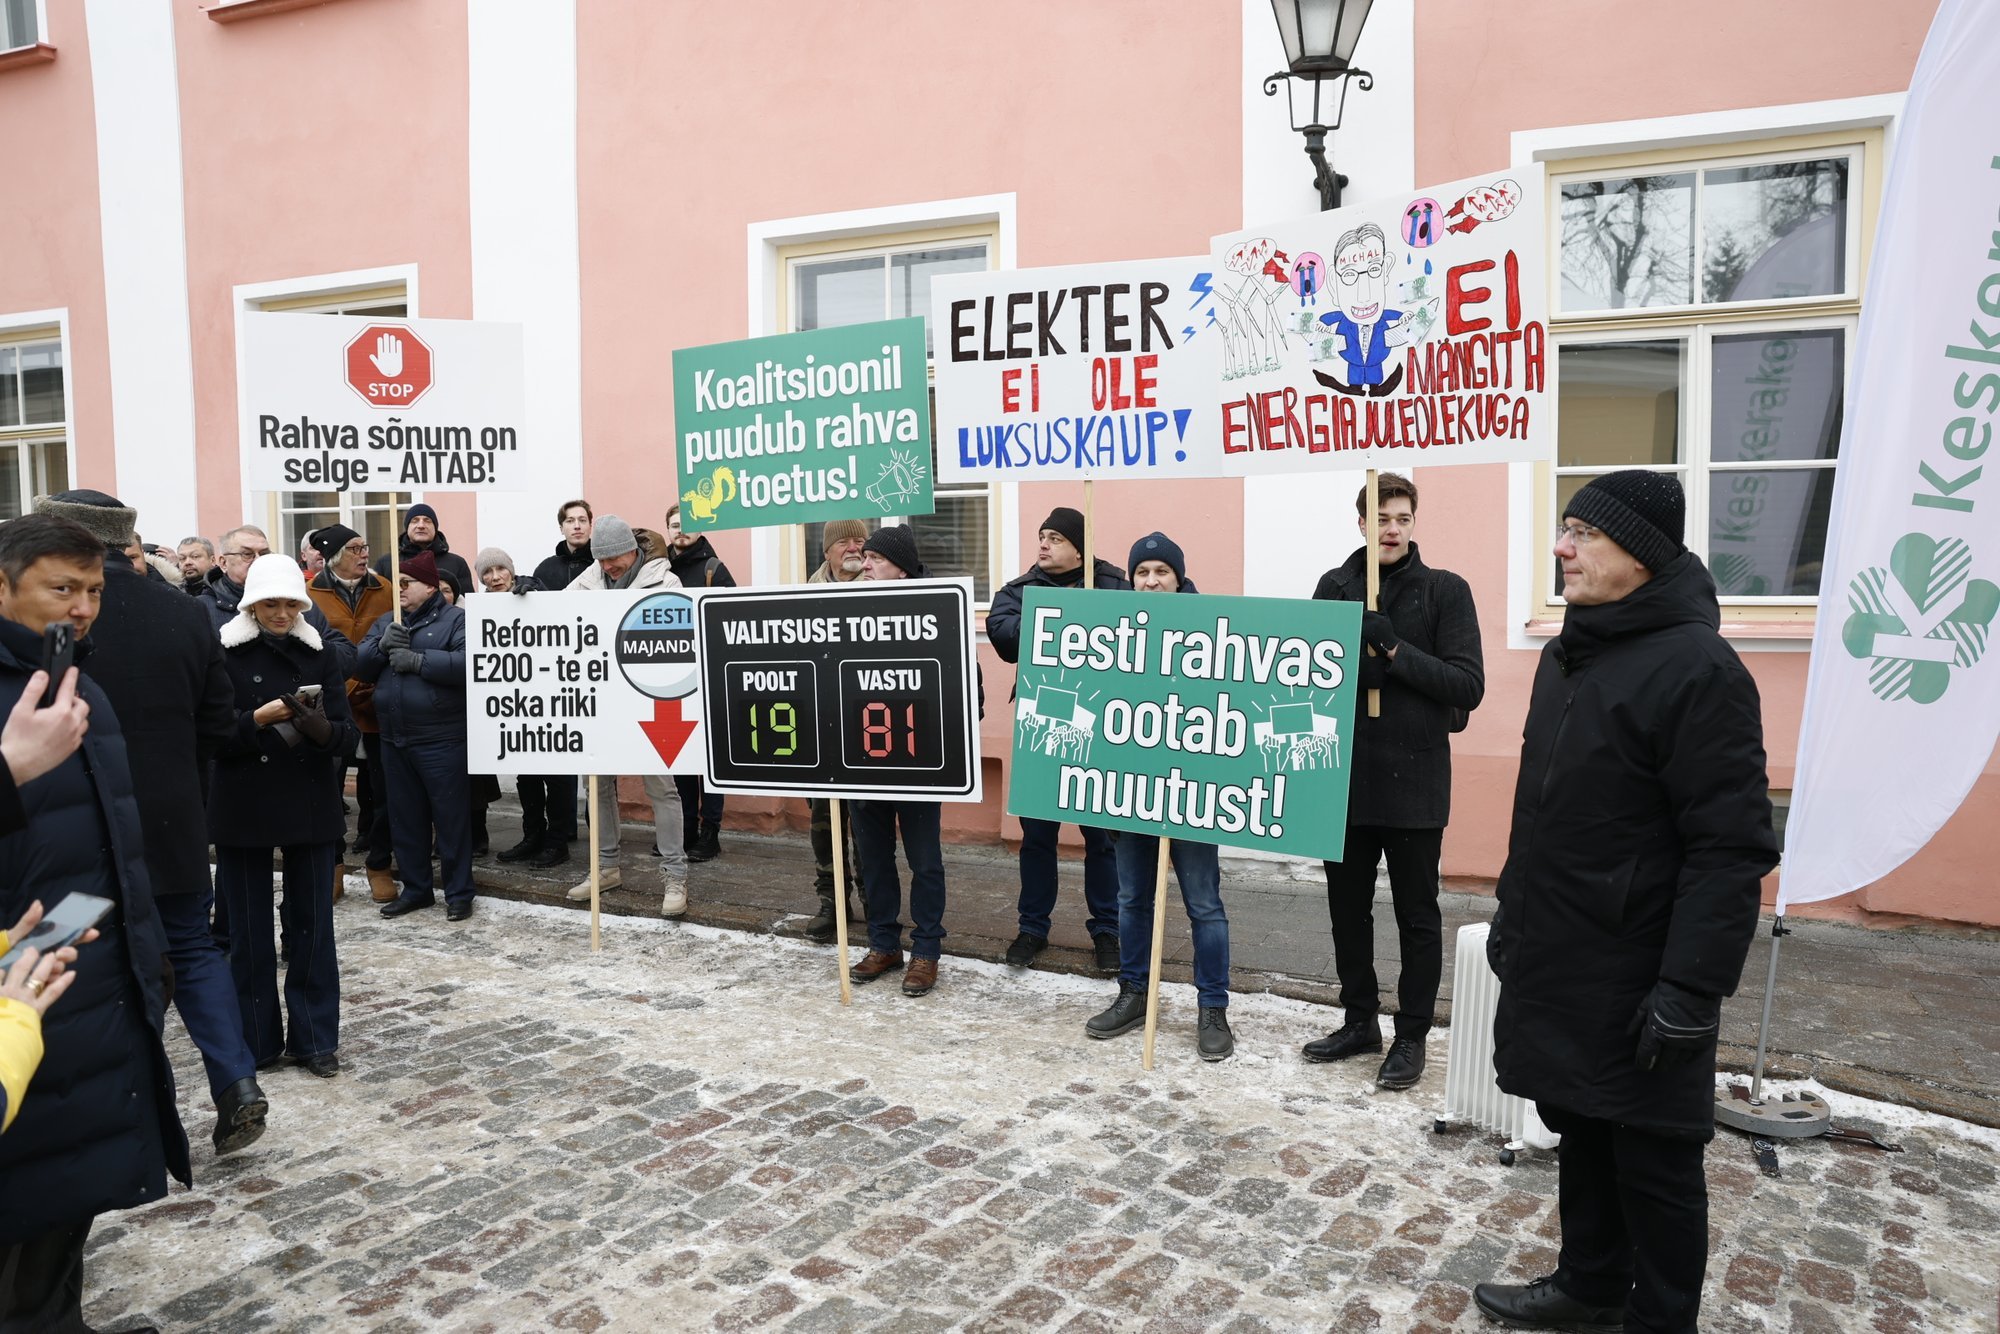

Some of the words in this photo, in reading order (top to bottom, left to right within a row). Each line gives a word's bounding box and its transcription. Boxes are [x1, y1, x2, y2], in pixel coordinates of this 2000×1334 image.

[1340, 249, 1380, 264] MICHAL
[1446, 249, 1521, 337] EI
[951, 282, 1174, 362] ELEKTER
[694, 345, 902, 413] Koalitsioonil
[1091, 354, 1158, 412] OLE
[1406, 321, 1544, 394] MÄNGITA
[368, 382, 414, 398] STOP
[259, 415, 359, 449] Rahva
[368, 417, 472, 451] sõnum
[481, 426, 517, 451] on
[685, 410, 805, 474] puudub
[816, 402, 919, 450] rahva
[958, 408, 1192, 468] LUKSUSKAUP!
[284, 451, 369, 492] selge
[400, 451, 496, 484] AITAB!
[738, 455, 858, 508] toetus!
[482, 618, 570, 648] Reform
[574, 616, 599, 654] ja
[642, 607, 692, 625] EESTI
[722, 618, 841, 645] VALITSUSE
[846, 614, 938, 643] TOETUS
[473, 653, 533, 683] E200
[556, 655, 581, 682] te
[587, 651, 609, 682] ei
[1031, 606, 1150, 674] Eesti
[1160, 617, 1345, 690] rahvas
[486, 688, 544, 718] oska
[551, 687, 596, 718] riiki
[743, 671, 798, 692] POOLT
[857, 669, 922, 691] VASTU
[497, 723, 584, 761] juhtida
[750, 702, 797, 756] 19
[862, 702, 915, 758] 81
[1103, 692, 1248, 758] ootab
[1057, 764, 1287, 839] muutust!
